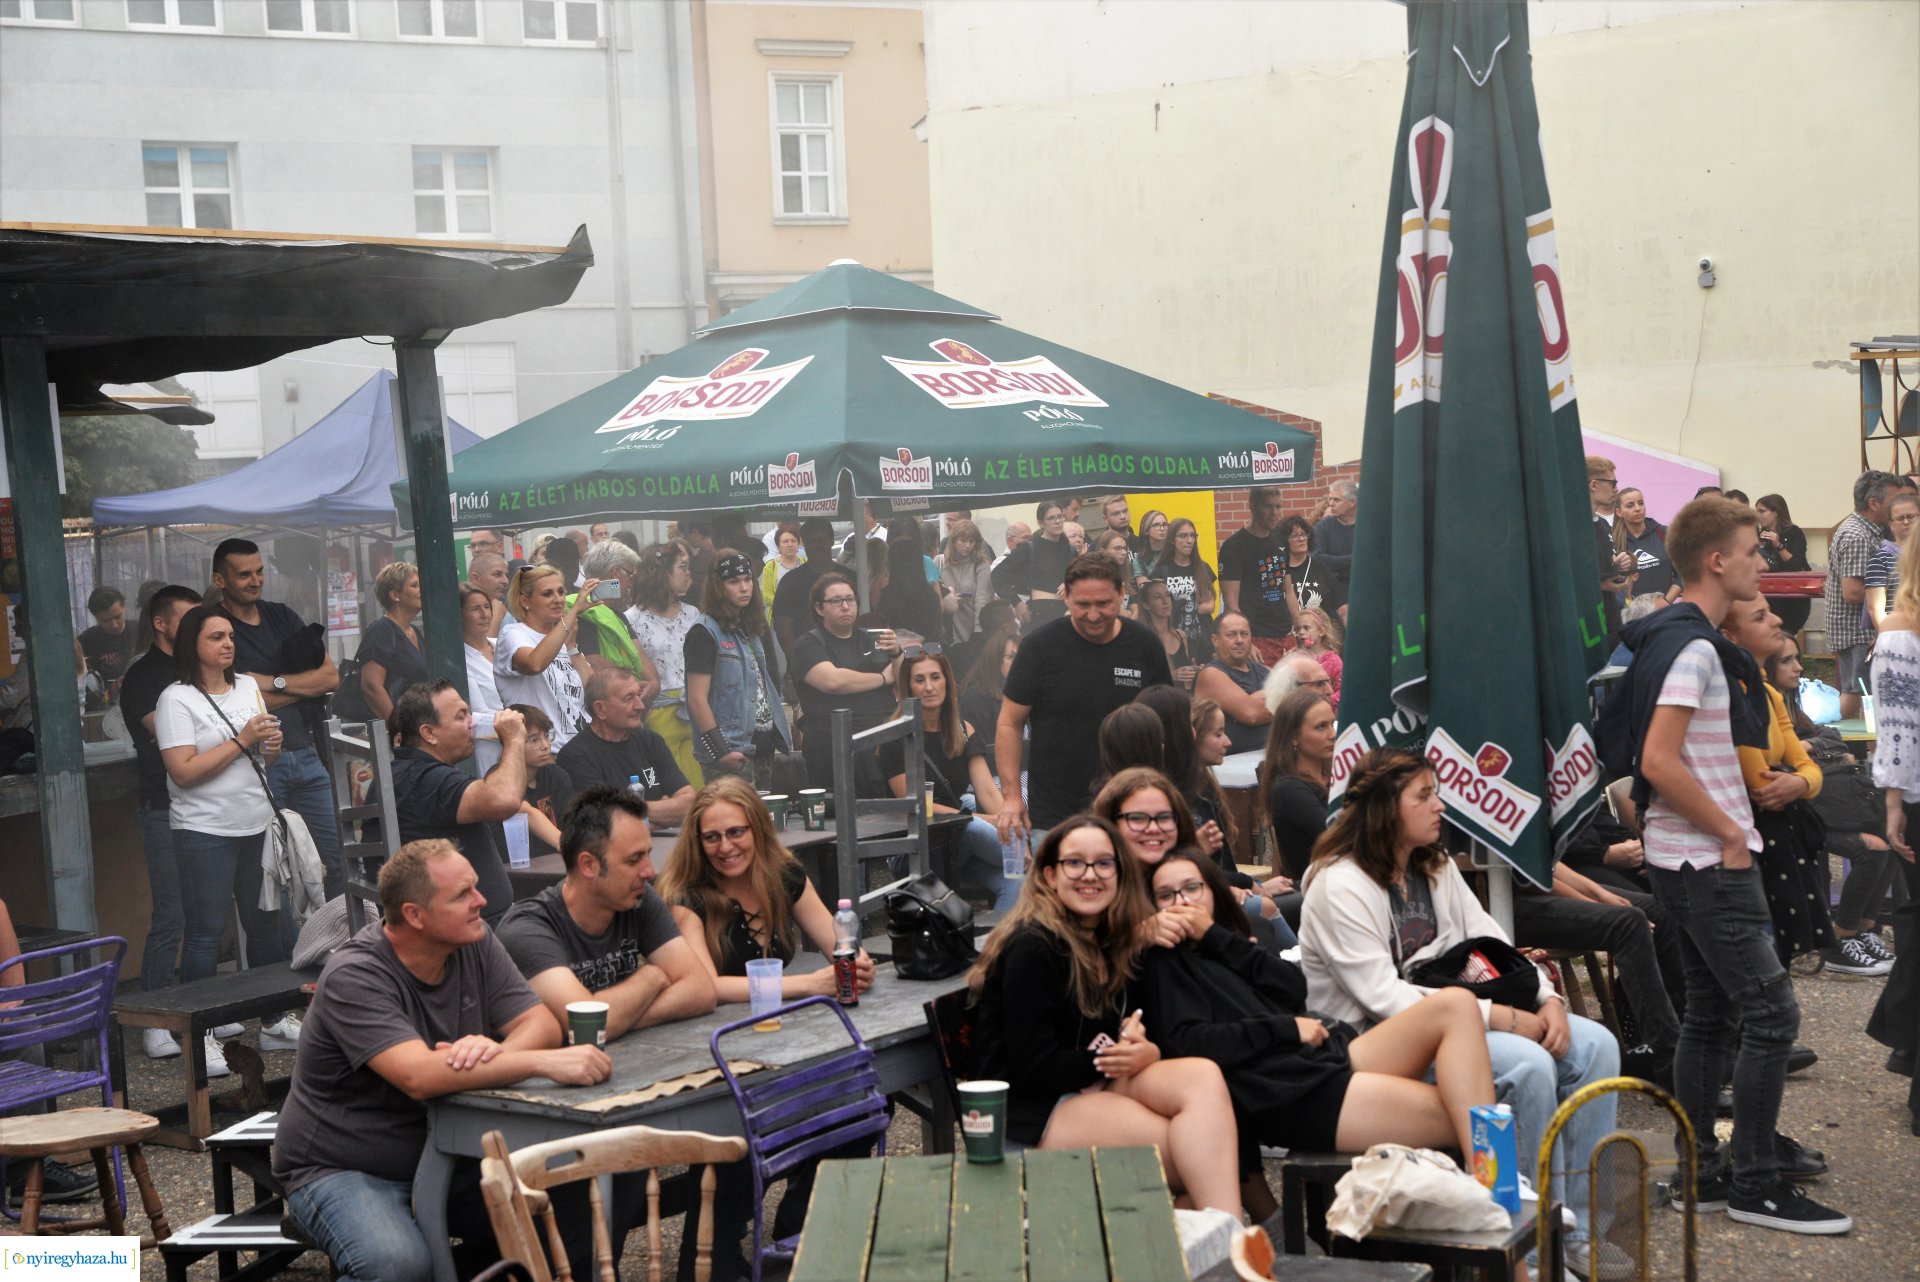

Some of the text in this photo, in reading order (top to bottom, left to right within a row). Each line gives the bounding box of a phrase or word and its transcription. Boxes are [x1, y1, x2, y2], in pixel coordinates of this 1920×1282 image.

[911, 368, 1085, 397] BORSODI
[618, 377, 785, 420] BORSODI
[935, 457, 972, 476] PÓLÓ
[985, 453, 1212, 480] AZ ÉLET HABOS OLDALA
[1218, 451, 1249, 469] PÓLÓ
[1254, 458, 1293, 474] BORSODI
[730, 465, 764, 486] PÓLÓ
[770, 471, 814, 490] BORSODI
[883, 467, 930, 483] BORSODI
[460, 491, 489, 510] PÓLÓ
[499, 473, 720, 511] AZ ÉLET HABOS OLDALA
